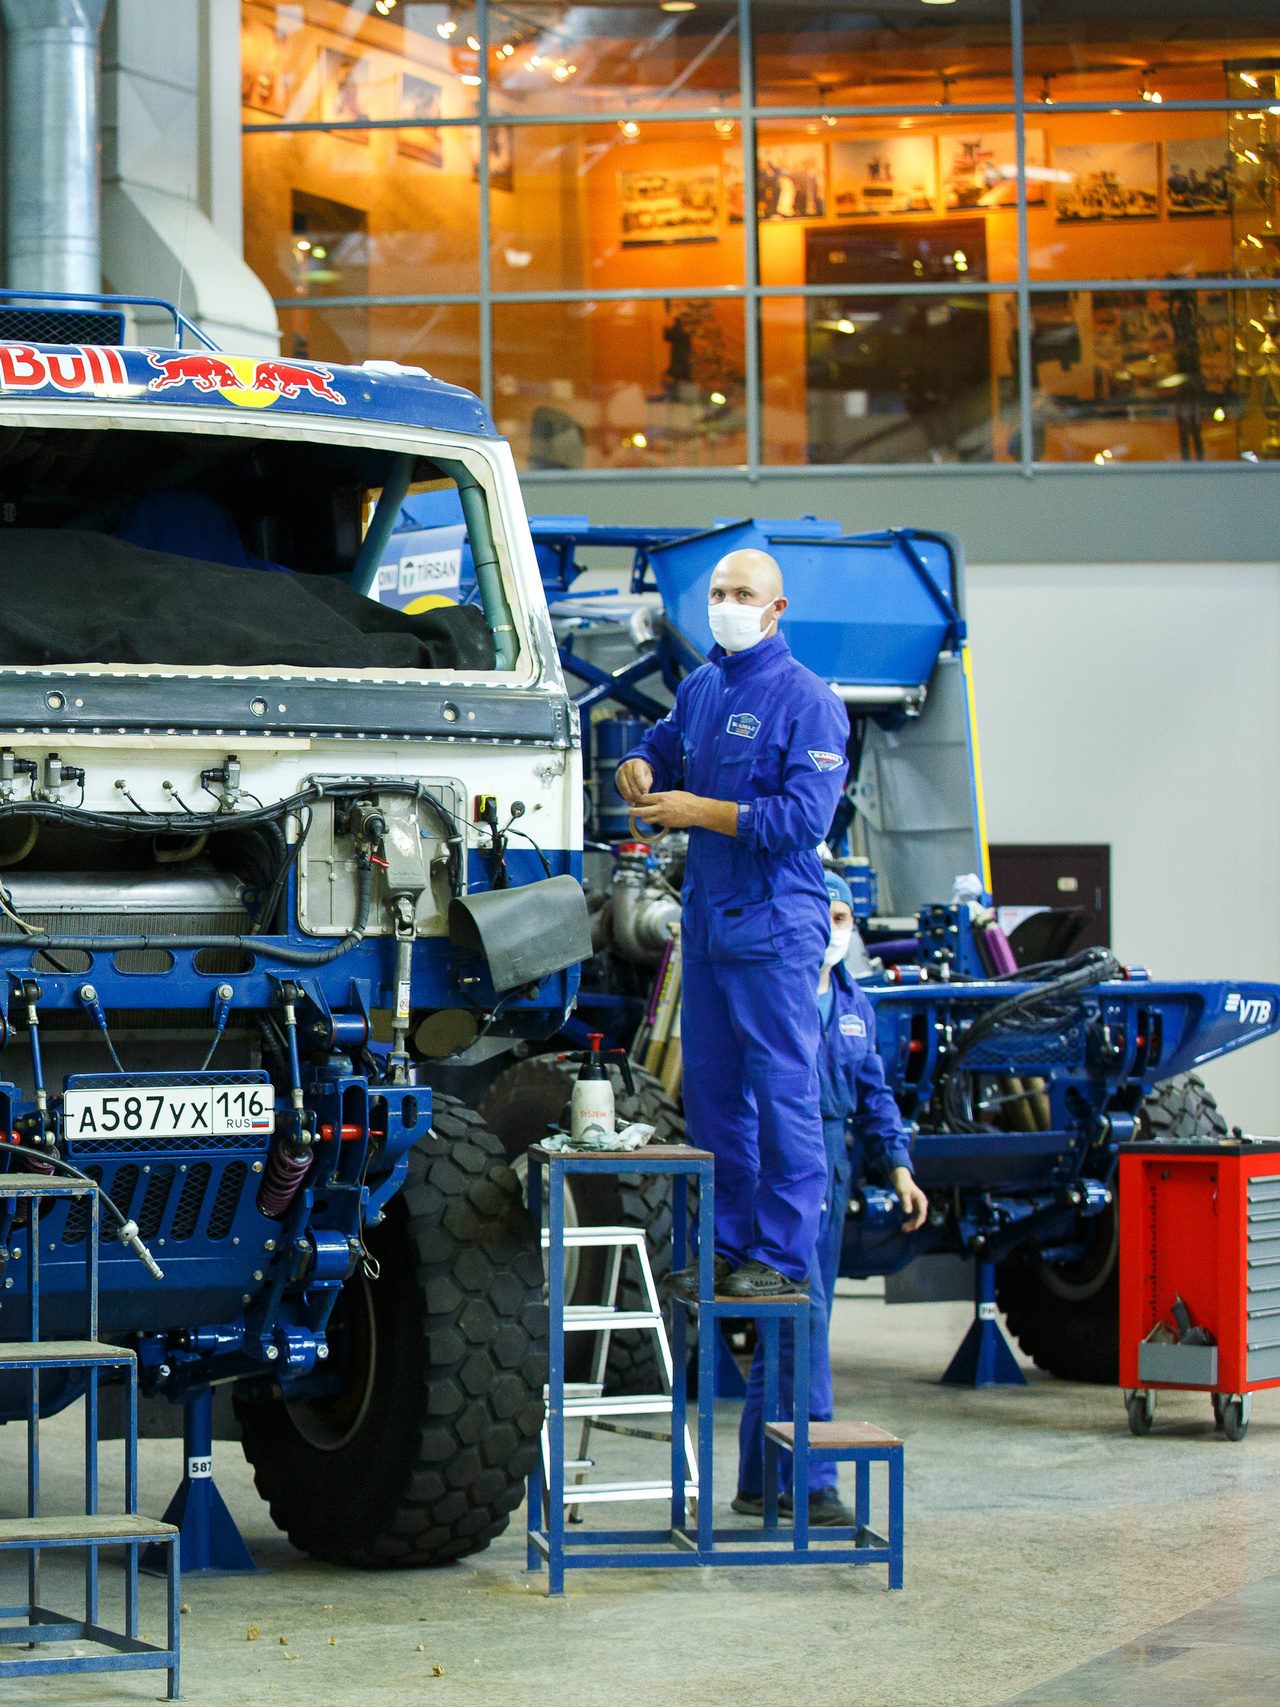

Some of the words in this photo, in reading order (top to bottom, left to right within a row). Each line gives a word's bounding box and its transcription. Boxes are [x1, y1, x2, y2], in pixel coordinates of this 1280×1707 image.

[1239, 1000, 1271, 1024] VTB
[216, 1090, 263, 1117] 116
[226, 1118, 251, 1129] RUS
